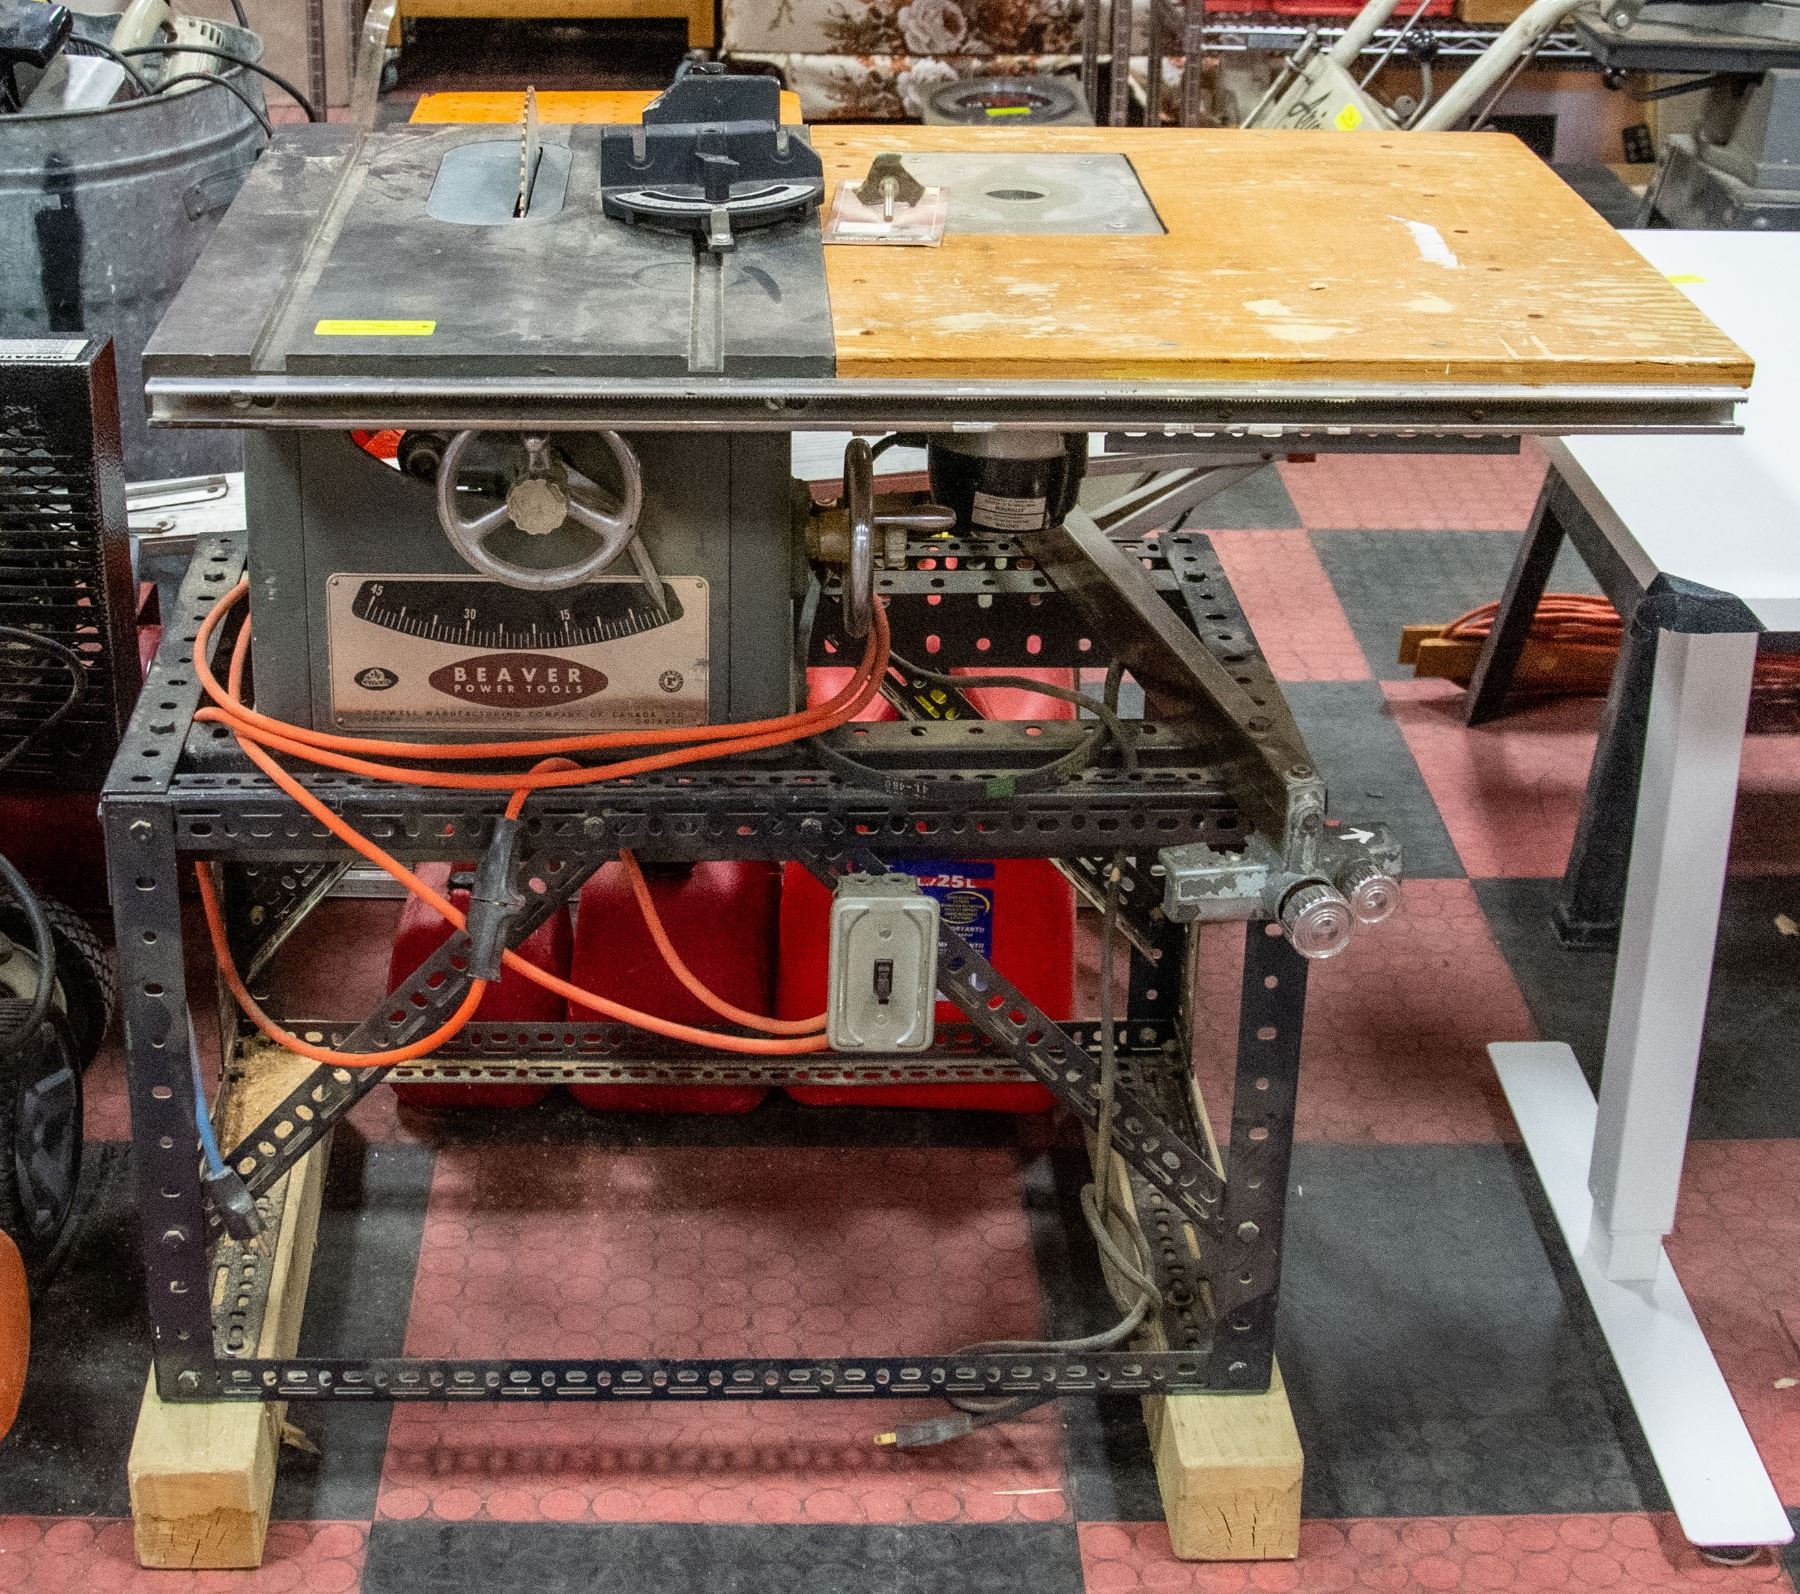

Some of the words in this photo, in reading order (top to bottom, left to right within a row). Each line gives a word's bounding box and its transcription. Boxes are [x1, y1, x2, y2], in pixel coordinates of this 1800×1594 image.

[371, 584, 384, 596] 45
[463, 608, 476, 620] 30
[560, 608, 571, 621] 15
[454, 667, 581, 683] BEAVER
[454, 684, 514, 693] POWER
[526, 685, 583, 694] TOOLS
[426, 710, 521, 718] MANUFACTURING
